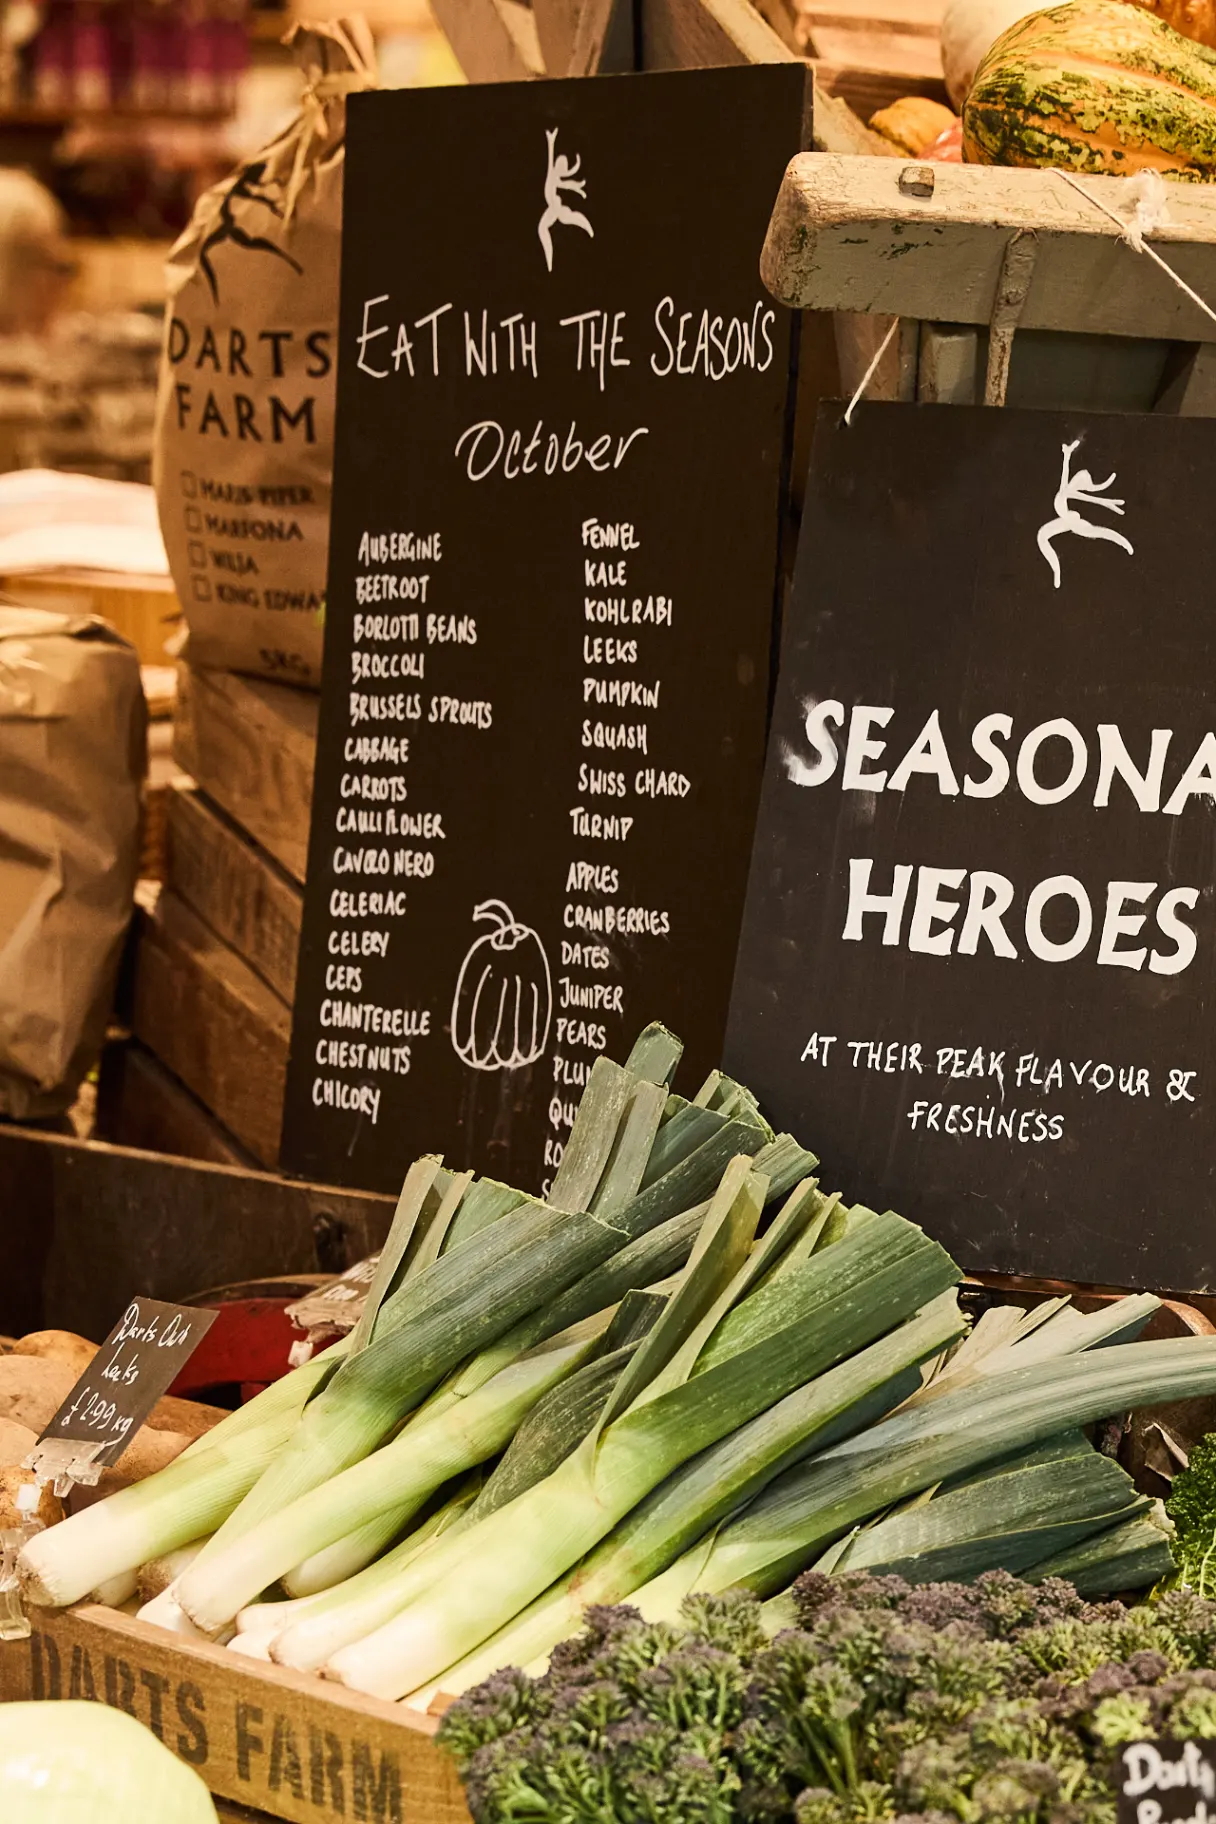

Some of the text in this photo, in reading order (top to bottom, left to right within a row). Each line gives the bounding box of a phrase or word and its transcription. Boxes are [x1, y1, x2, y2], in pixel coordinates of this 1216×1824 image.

[168, 316, 331, 380] DARTS
[560, 310, 630, 391] THE
[651, 296, 775, 380] SEASONS
[176, 383, 317, 445] FARM
[455, 420, 649, 481] October
[358, 532, 442, 566] AUBERGINE
[582, 518, 640, 551] FENNEL
[356, 574, 429, 604] BEETROOT
[585, 559, 626, 587] KALE
[585, 596, 672, 626] KOHLRABI
[427, 614, 477, 644] BEANS
[584, 635, 637, 664] LEEKS
[352, 651, 424, 684] BROCCOLI
[583, 678, 660, 708] PUMPKIN
[350, 692, 492, 729] BRUSSELS SPROUTS
[345, 736, 409, 764] CABBAGE
[582, 719, 647, 755] SQUASH
[341, 774, 407, 802] CARROTS
[578, 763, 691, 798] SWISS CHARD
[570, 807, 633, 841] TURNIP
[394, 849, 434, 878] NERO
[566, 861, 618, 893] APPLES
[330, 889, 406, 917] CELERIAC
[842, 859, 1200, 975] HEROES
[564, 904, 670, 936] CRANBERRIES
[328, 931, 389, 957] CELERY
[561, 941, 609, 969] DATES
[326, 964, 362, 993] CEPS
[559, 977, 623, 1013] JUNIPER
[320, 999, 430, 1036] CHANTERELLE
[557, 1018, 606, 1050] PEARS
[316, 1039, 411, 1074] CHESTNUTS
[552, 1055, 591, 1086] PLU
[801, 1032, 1197, 1104] AT THEIR PEAK FLAVOUR &
[313, 1078, 380, 1124] CHICORY
[548, 1097, 580, 1131] QU
[907, 1101, 1064, 1142] FRESHNESS
[30, 1630, 402, 1823] DARTS FARM
